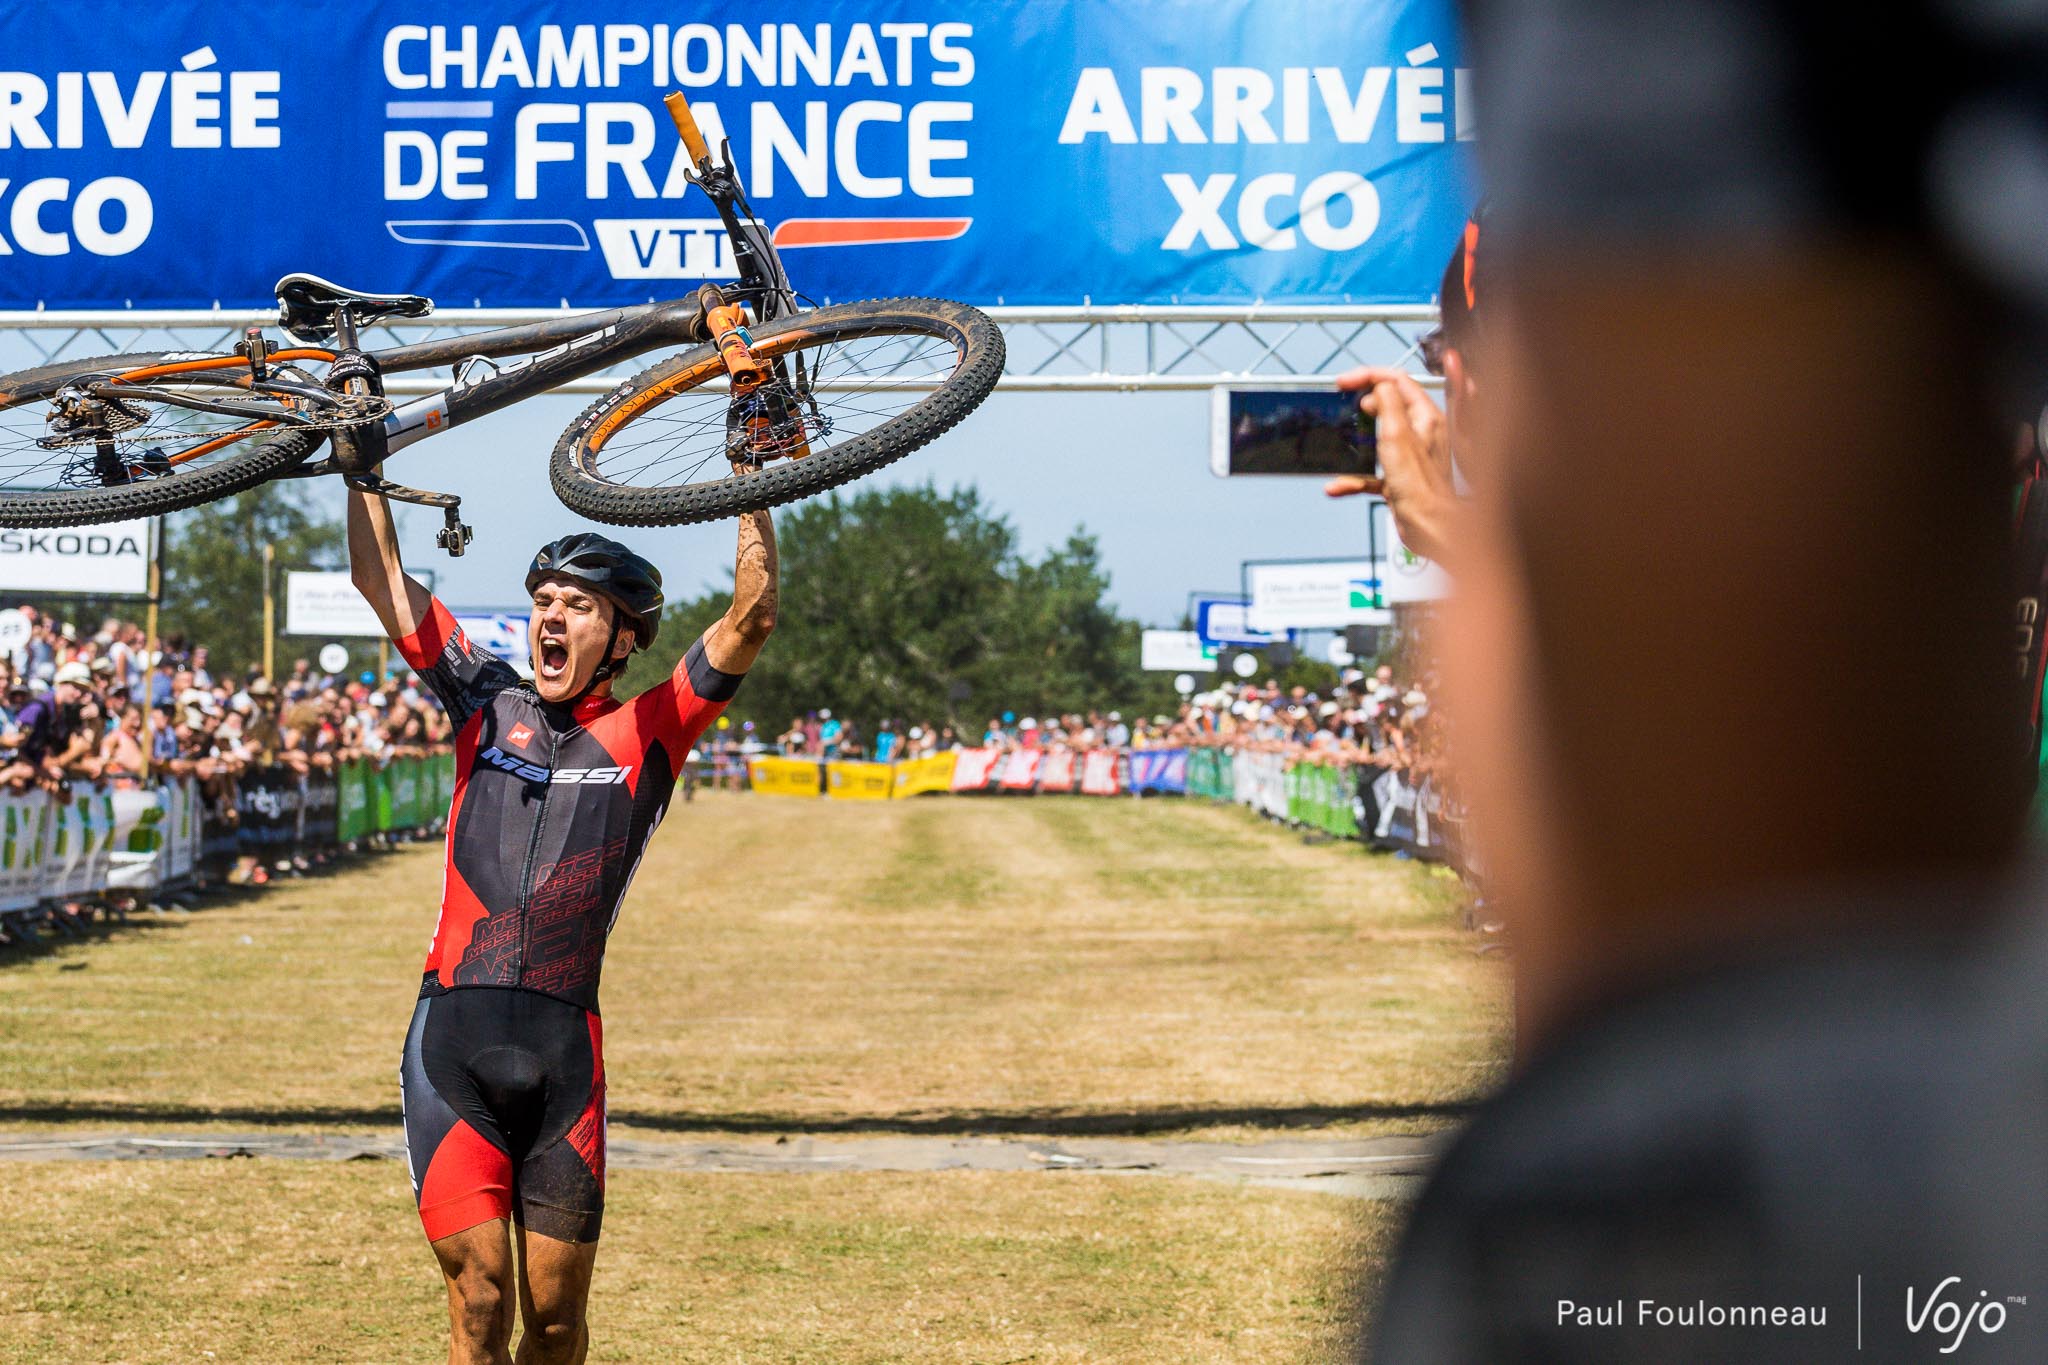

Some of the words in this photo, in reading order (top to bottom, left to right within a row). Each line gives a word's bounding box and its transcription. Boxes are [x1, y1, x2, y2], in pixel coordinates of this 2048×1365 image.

[383, 22, 976, 90] CHAMPIONNATS
[384, 130, 489, 201] DE
[515, 100, 975, 201] FRANCE
[0, 176, 153, 256] CO
[628, 229, 729, 270] VTT
[1161, 171, 1381, 252] XCO
